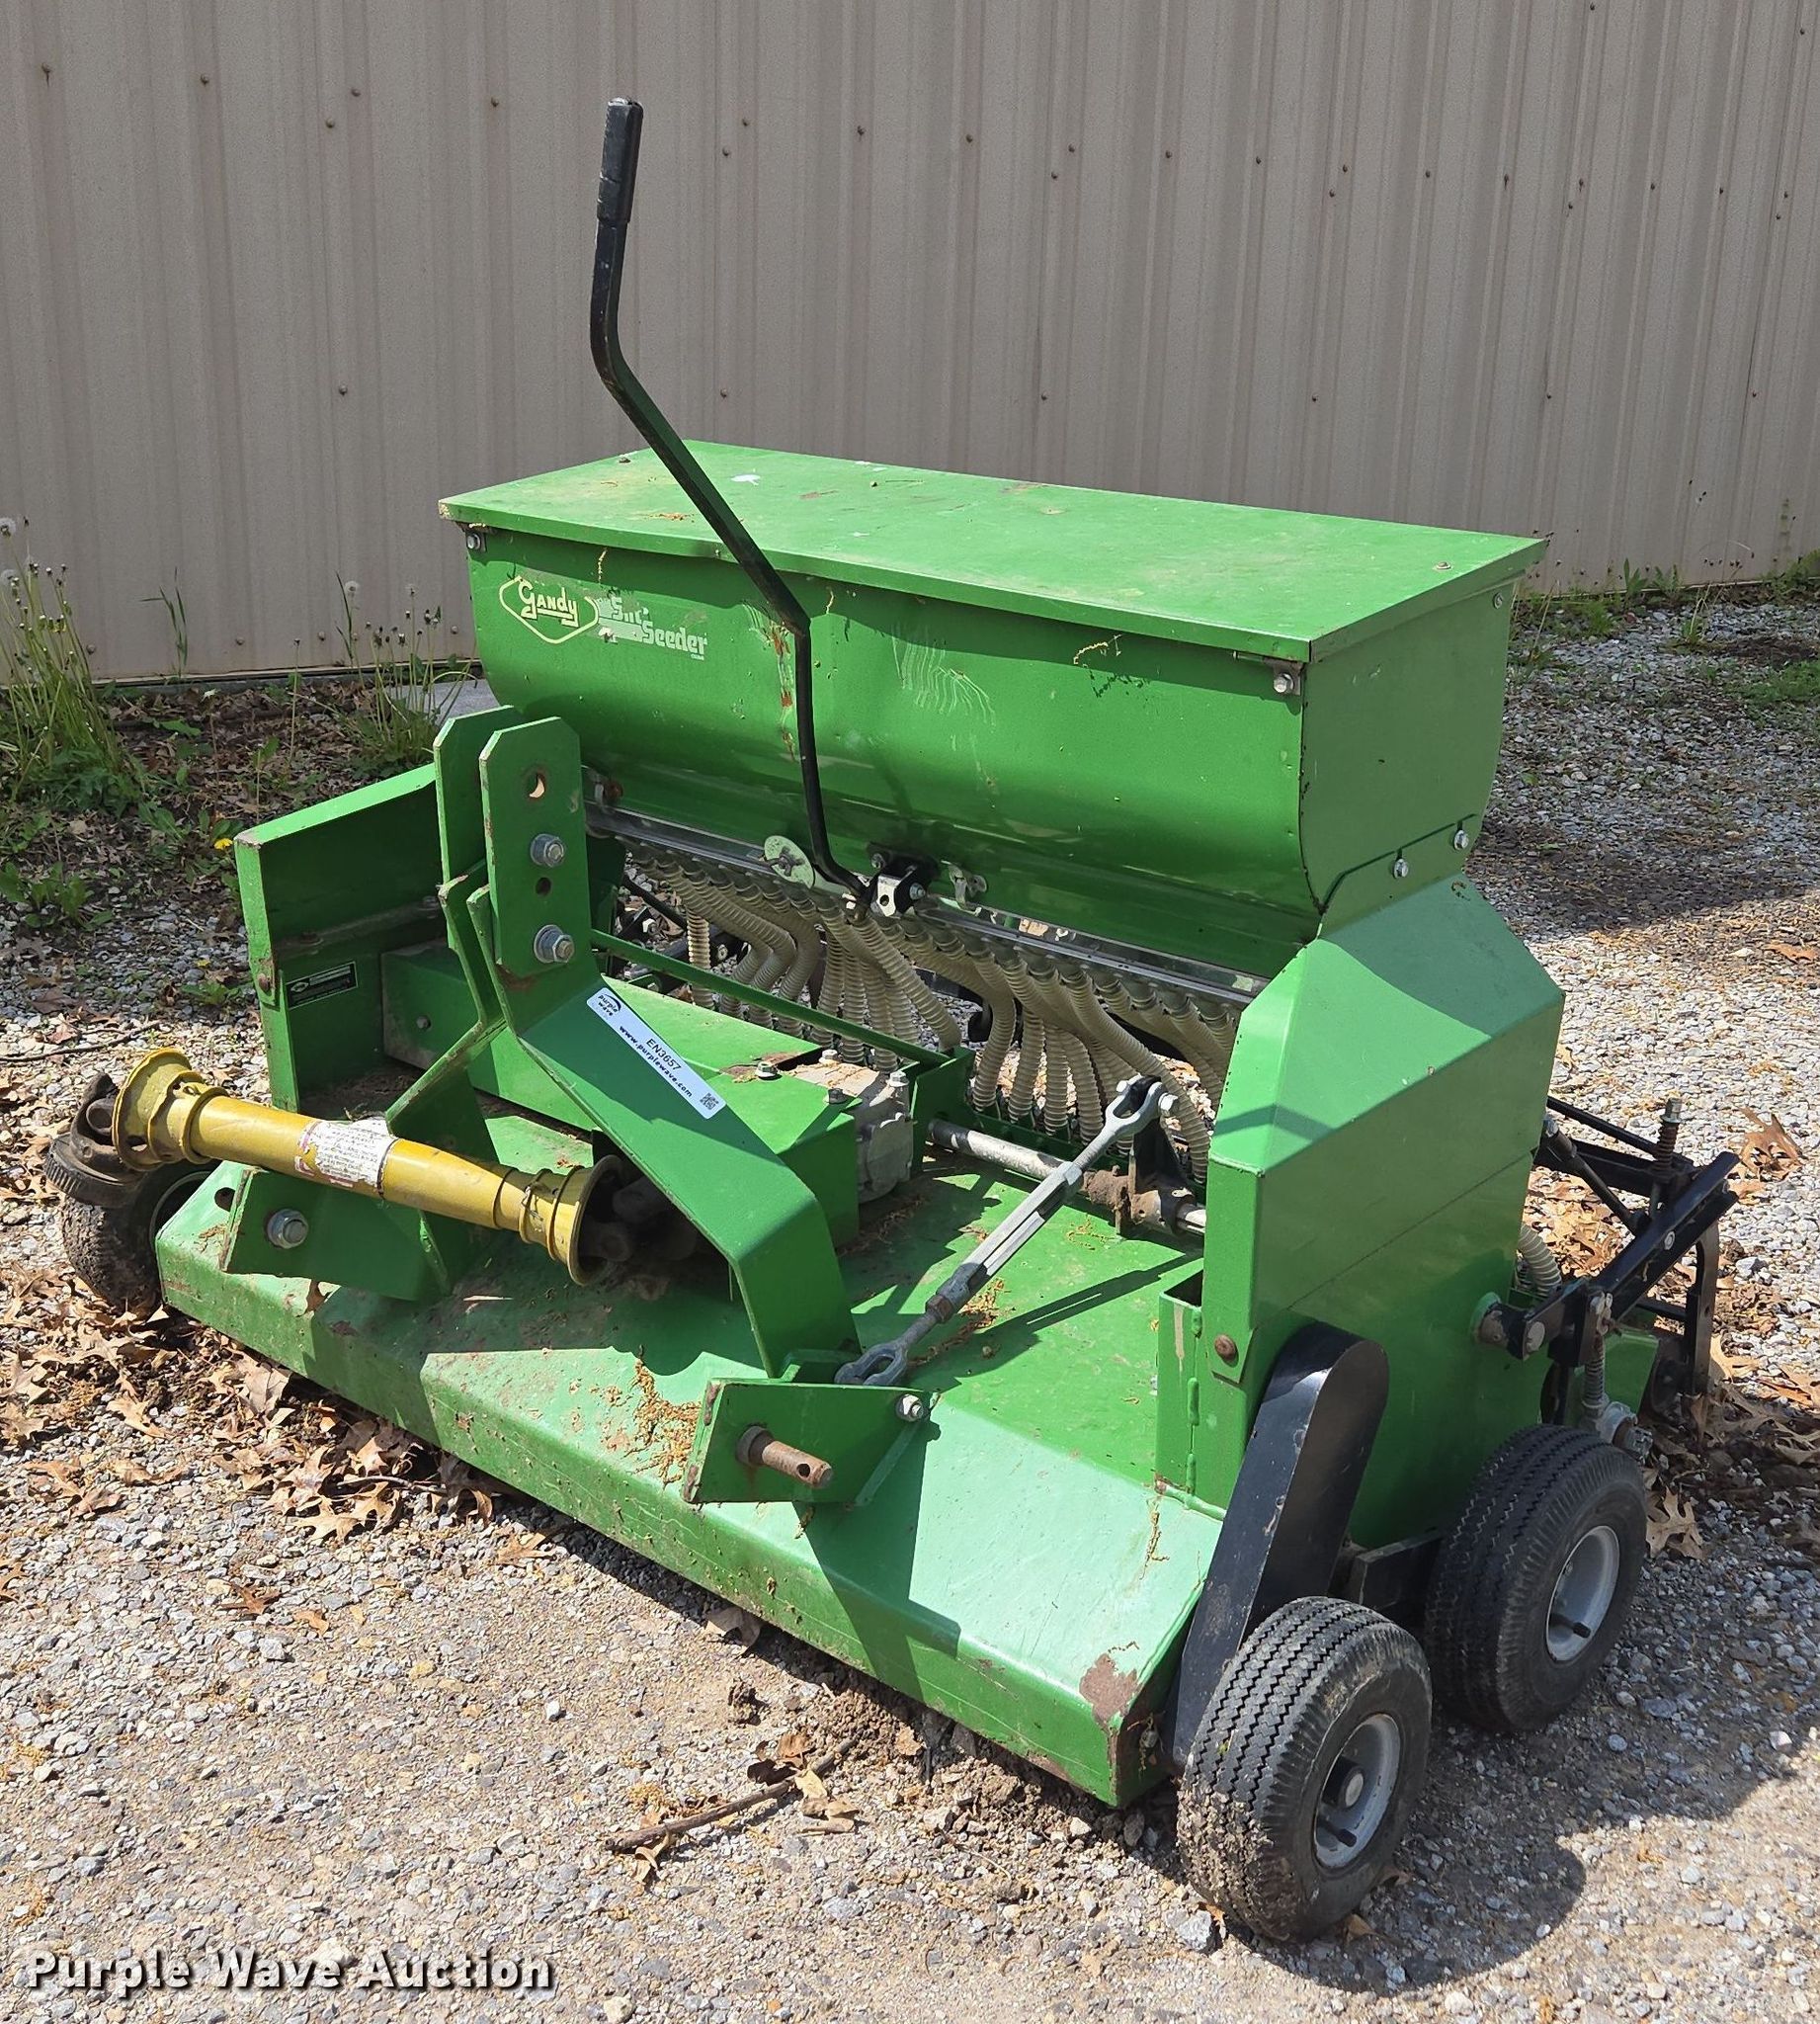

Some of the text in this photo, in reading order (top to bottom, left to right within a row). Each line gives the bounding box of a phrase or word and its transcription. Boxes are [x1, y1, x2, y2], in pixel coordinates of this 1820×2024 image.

[641, 620, 708, 654] Seeder
[619, 1025, 694, 1098] www.purplewave.com
[645, 1038, 682, 1071] EN3657
